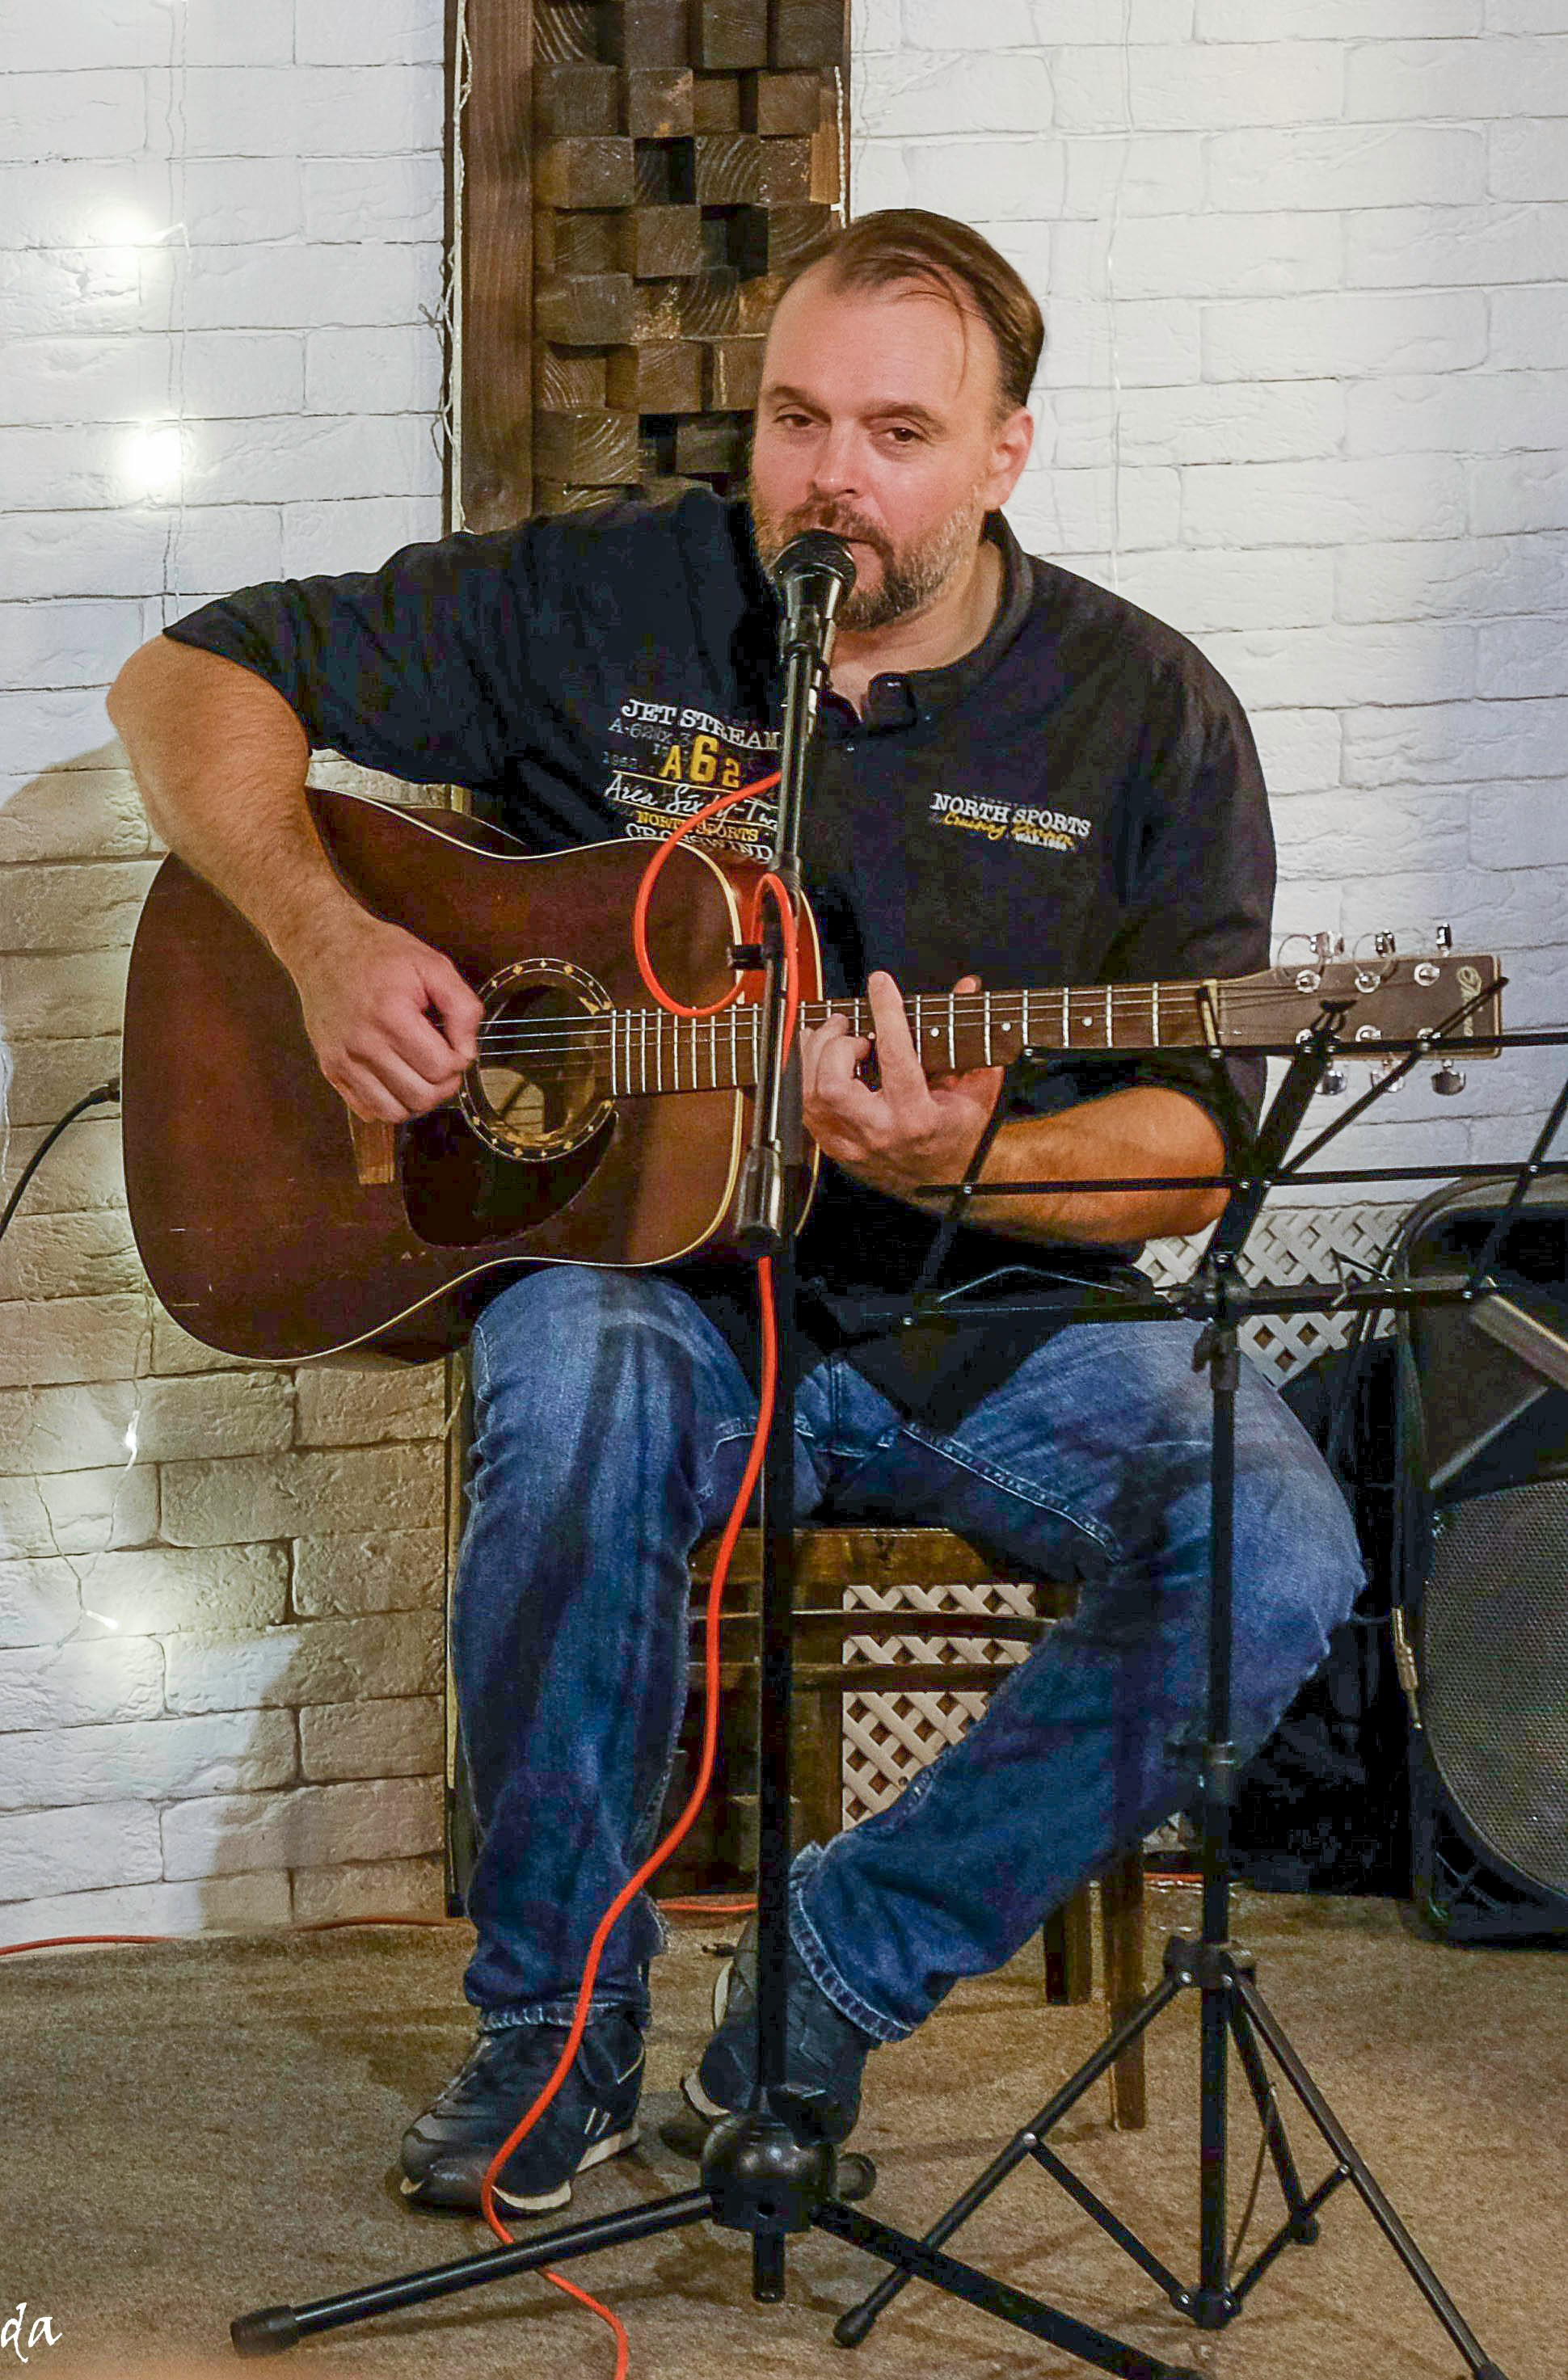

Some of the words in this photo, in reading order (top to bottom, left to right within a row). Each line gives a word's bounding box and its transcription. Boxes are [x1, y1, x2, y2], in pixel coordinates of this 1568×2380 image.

[622, 698, 677, 725] JET
[605, 773, 659, 807] Area
[636, 811, 693, 833] NORT
[929, 793, 1010, 824] NORTH
[1013, 808, 1091, 838] SPORTS
